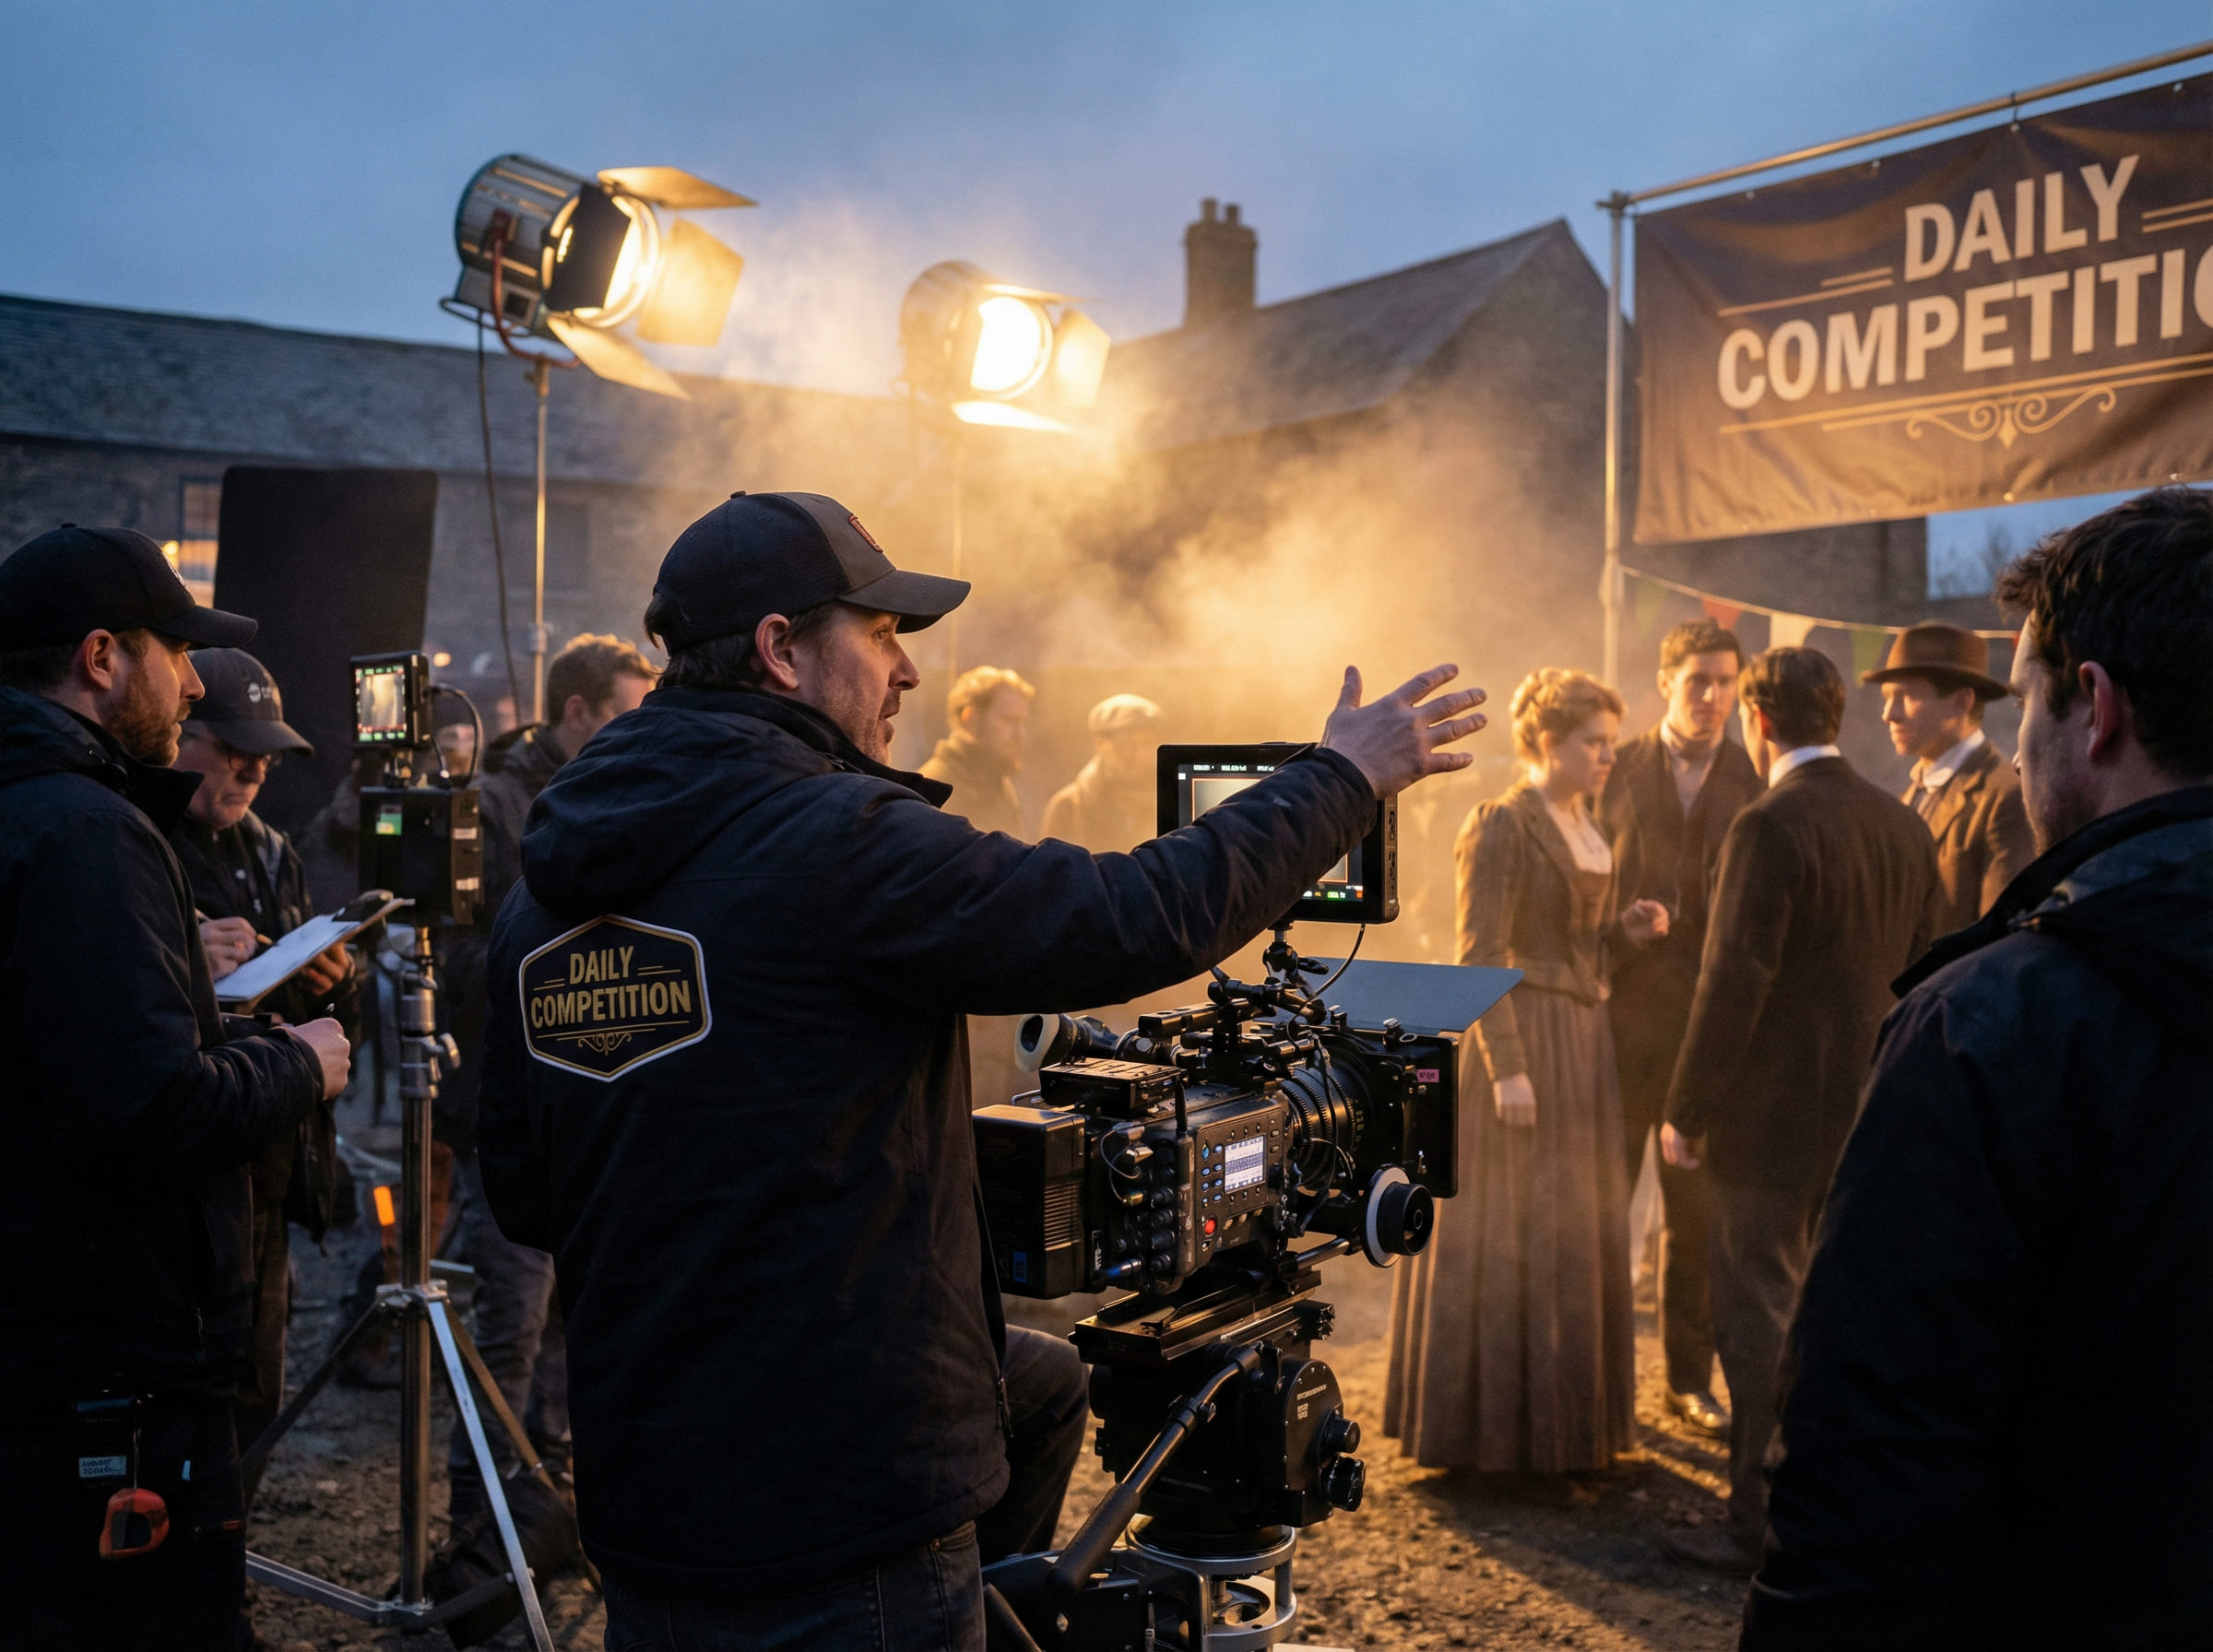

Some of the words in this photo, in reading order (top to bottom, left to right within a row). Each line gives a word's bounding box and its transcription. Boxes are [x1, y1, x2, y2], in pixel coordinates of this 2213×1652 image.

[1904, 154, 2139, 282] DAILY
[569, 945, 634, 985] DAILY
[530, 979, 692, 1029] COMPETITION
